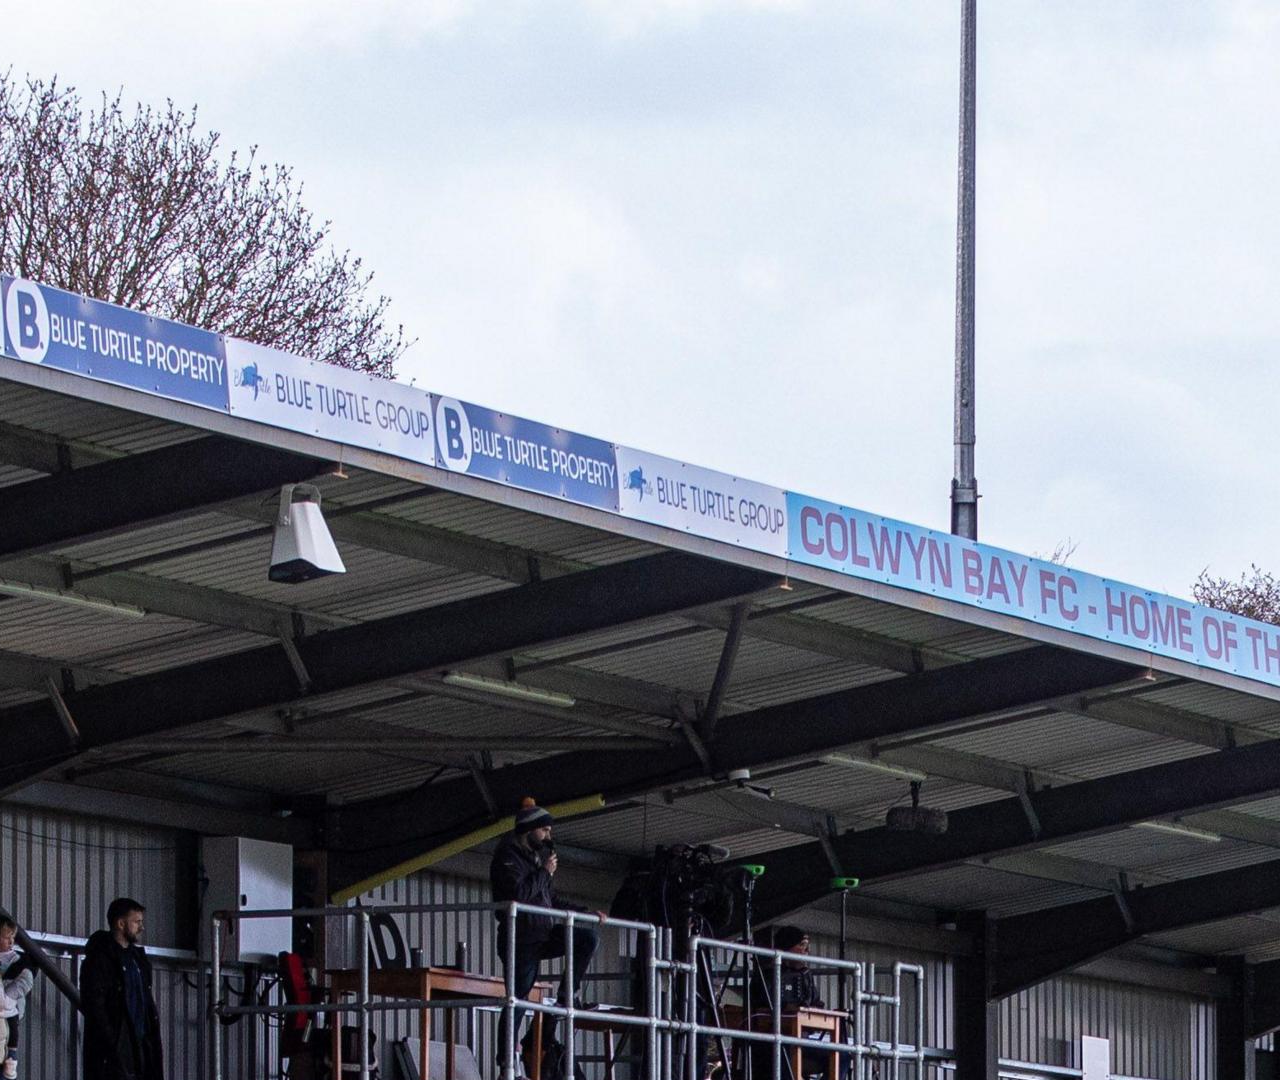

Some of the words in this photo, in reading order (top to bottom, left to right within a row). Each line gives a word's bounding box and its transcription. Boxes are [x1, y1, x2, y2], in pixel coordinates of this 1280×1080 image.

[50, 312, 87, 351] BLUE
[89, 323, 143, 367] TURTLE
[146, 338, 225, 387] PROPERTY
[275, 372, 313, 412] BLUE
[315, 382, 372, 425] TURTLE
[375, 398, 430, 441] GROUP
[472, 426, 504, 461] BLUE
[504, 435, 550, 473] TURTLE
[552, 448, 616, 490] PROPERTY
[656, 475, 689, 511] BLUE
[689, 484, 735, 524] TURTLE
[737, 498, 785, 536] GROUP
[800, 505, 953, 589] COLWYN
[962, 547, 1029, 608] BAY
[1039, 568, 1080, 622] FC
[1104, 586, 1194, 654] HOME
[1202, 615, 1238, 663] OF
